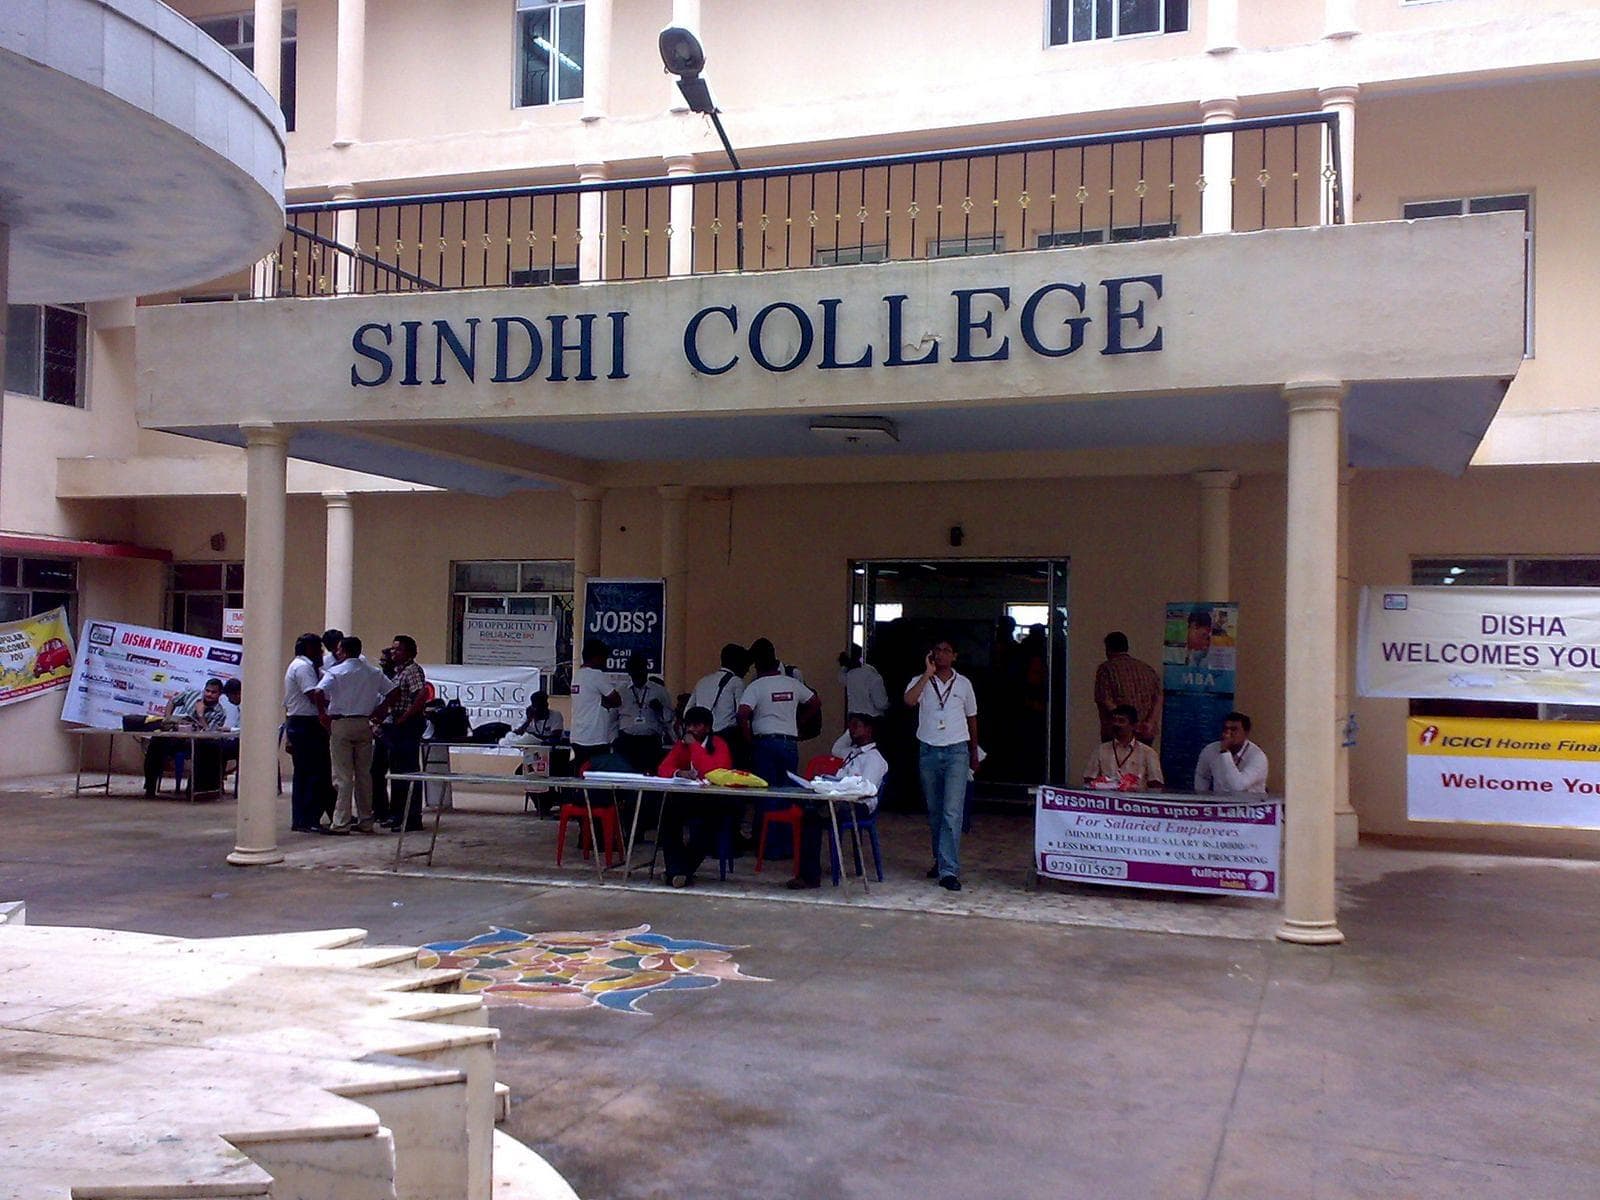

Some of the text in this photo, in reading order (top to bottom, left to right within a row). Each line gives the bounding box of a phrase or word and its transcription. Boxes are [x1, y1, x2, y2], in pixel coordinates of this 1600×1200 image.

[351, 274, 1163, 387] SINDHI COLLEGE
[468, 620, 549, 632] JOB OPPORTUNITY
[589, 611, 658, 633] JOBS?
[1482, 614, 1567, 637] DISHA
[121, 632, 152, 650] DISHA
[153, 638, 205, 658] PARTNERS
[612, 648, 632, 657] Call
[1382, 642, 1540, 666] WELCOMES
[1442, 736, 1492, 749] ICICI
[1496, 738, 1551, 751] Home
[1441, 773, 1553, 792] Welcome
[1043, 789, 1110, 810] Personal
[1114, 798, 1159, 815] Loans
[1163, 806, 1199, 818] upto
[1203, 807, 1213, 817] 5
[1075, 814, 1239, 837] For Salaried Employees
[1079, 843, 1161, 857] DOCUMENTATION
[1050, 861, 1122, 876] 9791015627
